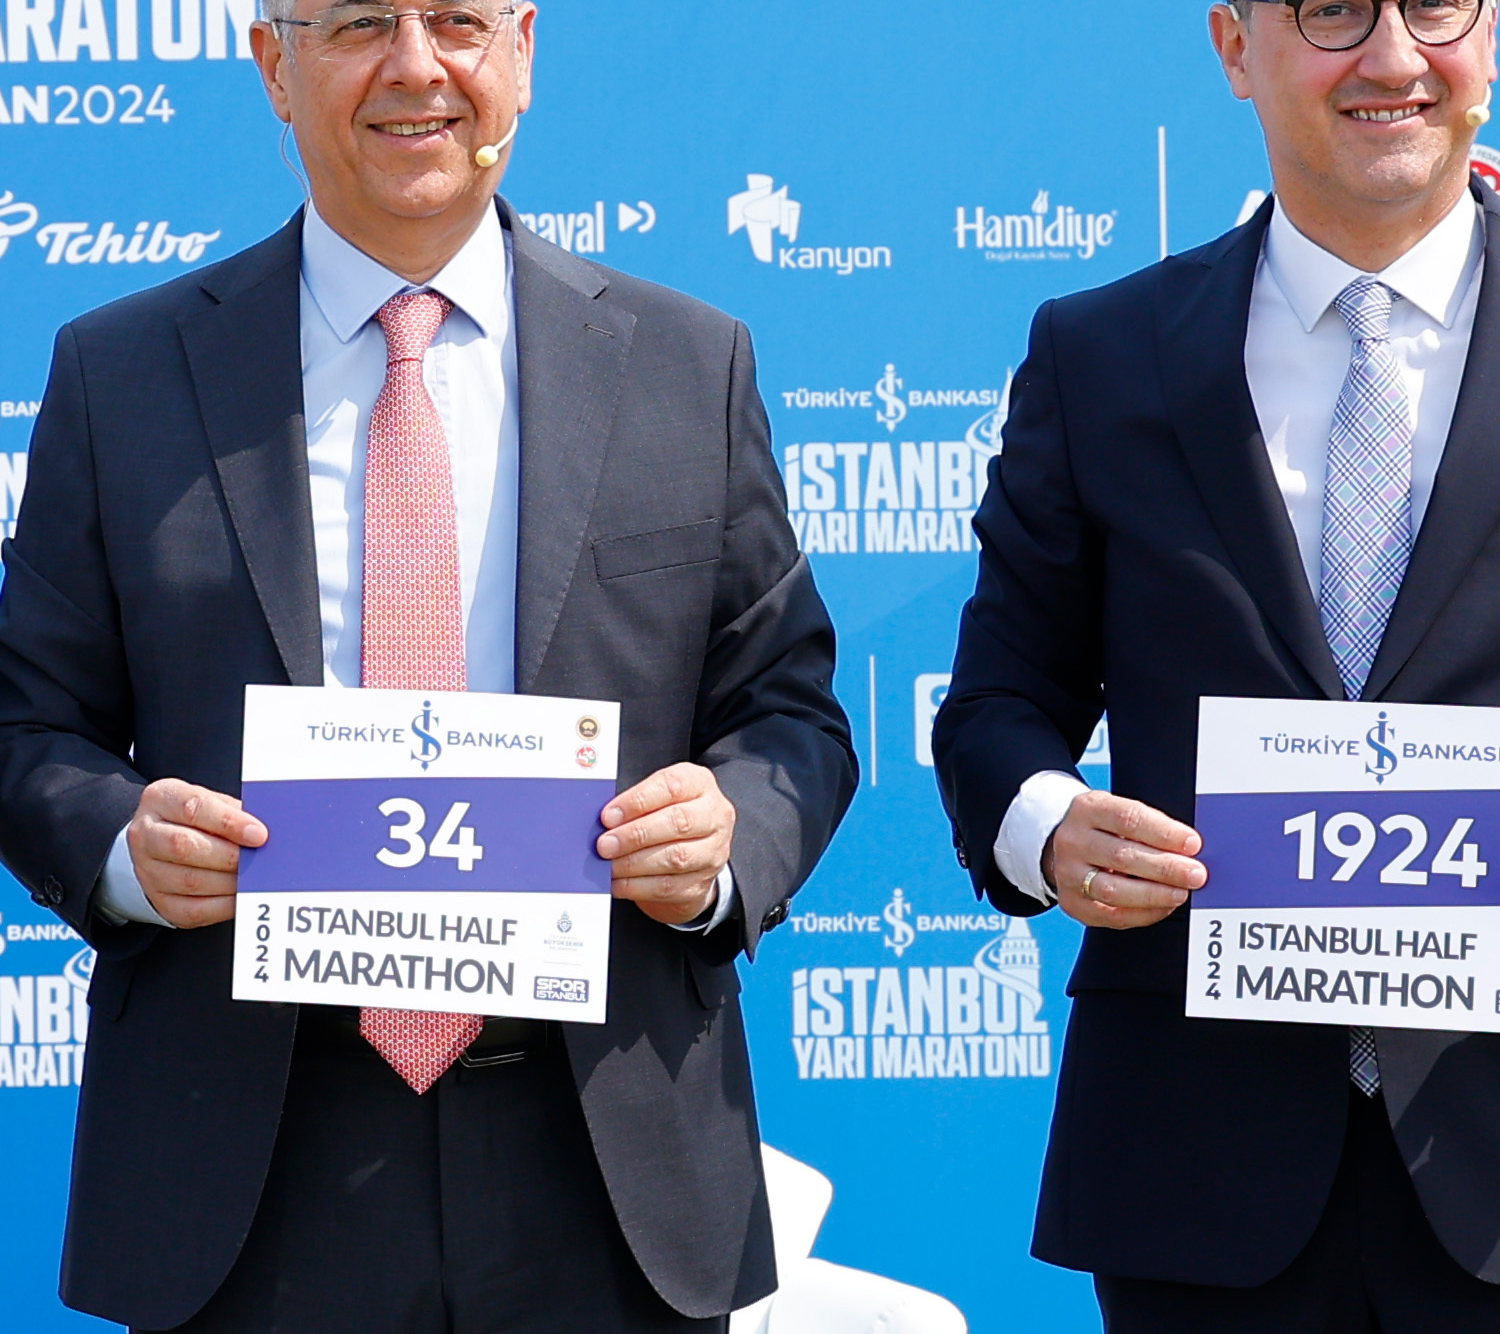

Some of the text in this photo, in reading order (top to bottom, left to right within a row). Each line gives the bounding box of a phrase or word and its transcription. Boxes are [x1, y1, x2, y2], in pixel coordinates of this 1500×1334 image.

[55, 83, 174, 125] 2024
[36, 222, 222, 265] Tchibo
[954, 206, 1114, 260] Hamidiye
[782, 388, 873, 408] TÜRKİYE
[909, 389, 998, 405] BANKASI
[785, 442, 989, 511] İSTANB
[788, 510, 975, 553] YARI MARAT
[307, 722, 405, 744] TÜRKİYE
[447, 730, 543, 751] BANKASI
[1259, 733, 1360, 756] TÜRKİYE
[375, 797, 484, 871] 34
[1283, 810, 1487, 888] 1924
[7, 925, 84, 941] BANKA
[287, 906, 518, 946] ISTANBUL HALF
[790, 912, 881, 933] TÜRKİYE
[917, 915, 1006, 931] BANKASI
[1239, 922, 1478, 961] ISTANBUL HALF
[284, 948, 514, 996] MARATHON
[537, 978, 585, 993] SPOR
[1236, 965, 1475, 1011] MARATHON
[792, 1035, 1050, 1079] YARI MARATONU
